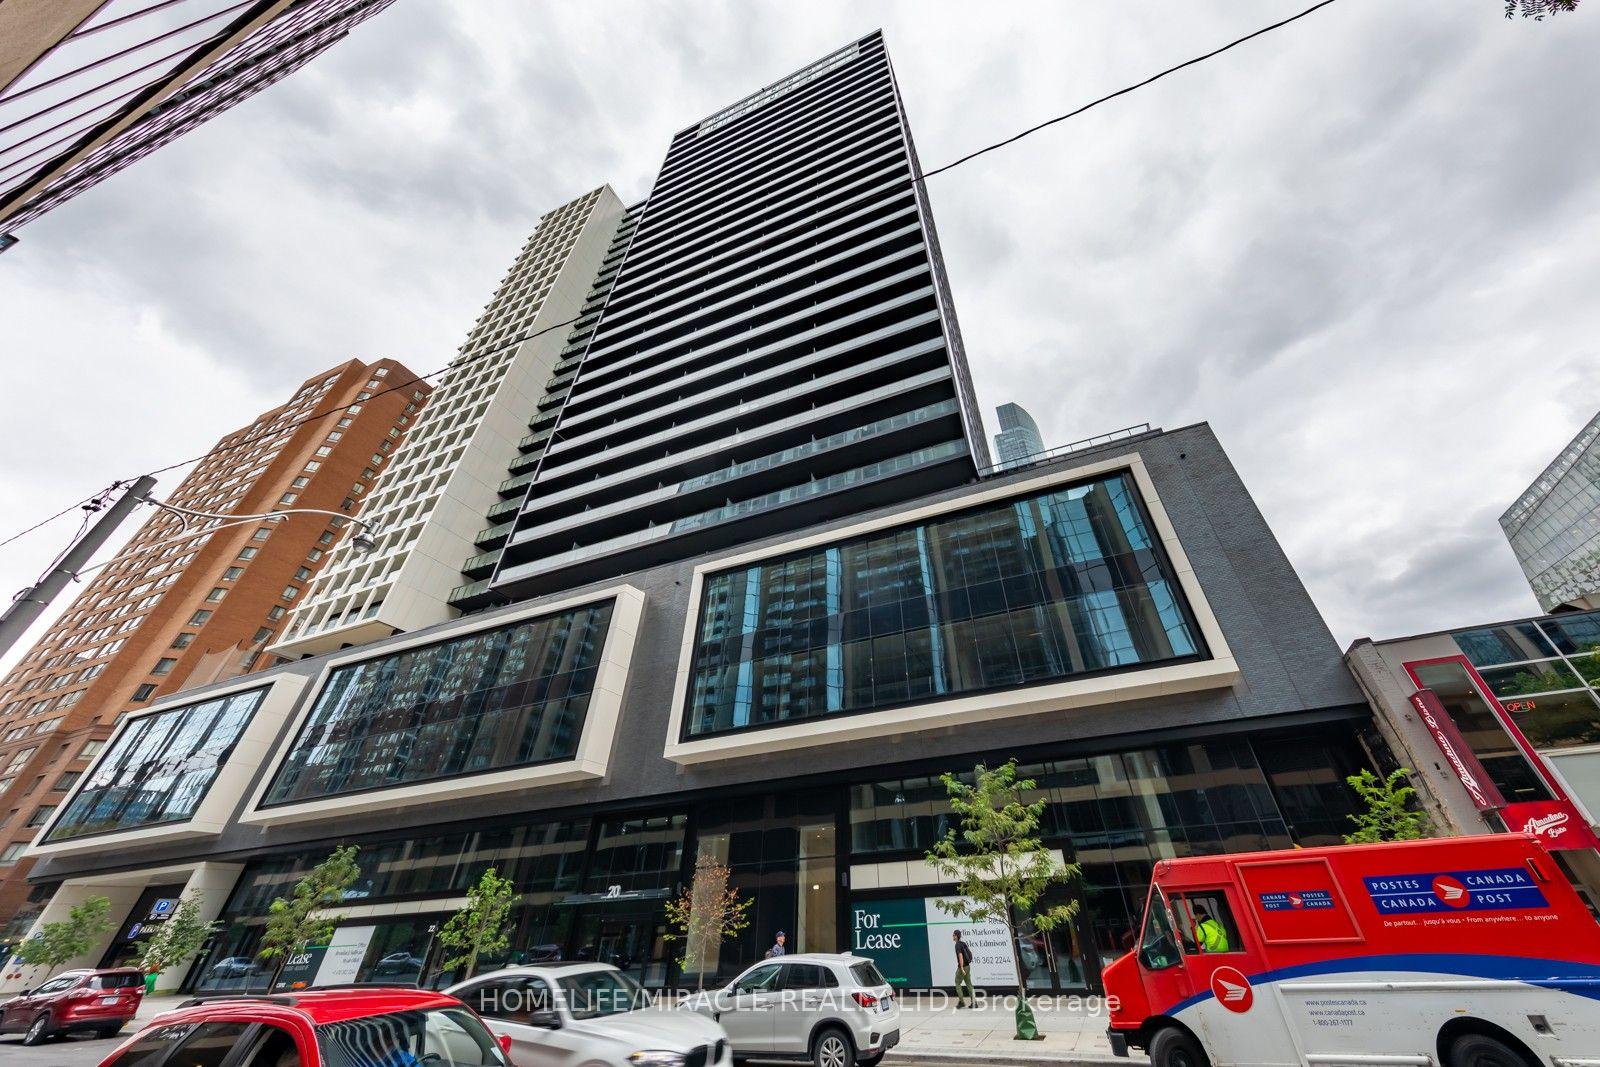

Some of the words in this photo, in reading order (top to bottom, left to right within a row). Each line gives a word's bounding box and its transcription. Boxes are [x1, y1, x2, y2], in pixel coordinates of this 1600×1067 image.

[1507, 701, 1536, 712] OPEN
[1372, 879, 1420, 891] POSTES
[1466, 873, 1527, 886] CANADA
[608, 885, 621, 898] 20
[1381, 896, 1437, 909] CANADA
[1476, 893, 1513, 904] POST
[855, 909, 881, 930] For
[1383, 920, 1393, 928] De
[1533, 914, 1560, 922] anyone
[855, 930, 902, 950] Lease
[286, 953, 313, 965] Lease
[982, 956, 994, 964] 362
